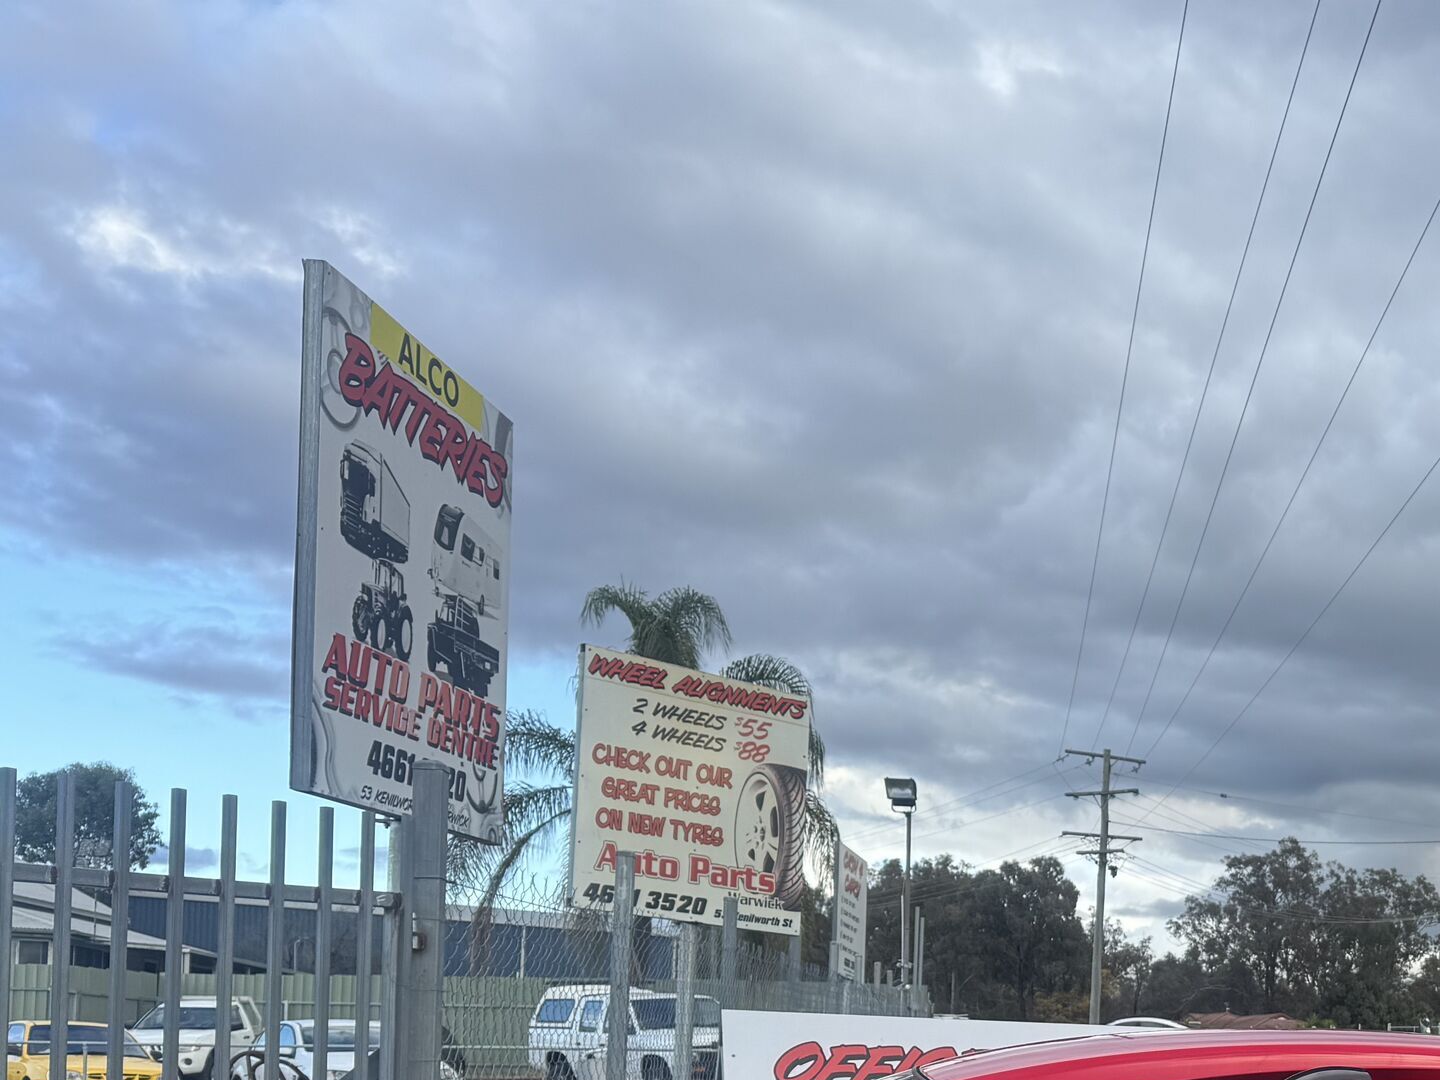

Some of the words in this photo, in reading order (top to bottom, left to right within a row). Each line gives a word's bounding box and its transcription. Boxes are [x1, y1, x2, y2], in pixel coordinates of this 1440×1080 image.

[399, 333, 459, 408] ALCO
[339, 332, 508, 508] BATTERIES
[321, 632, 411, 705] AUTO
[418, 671, 501, 743] PARTS
[323, 675, 422, 741] SERVICE
[588, 653, 668, 690] WHEEL
[672, 675, 808, 720] ALIGNMENTS
[633, 698, 648, 714] 2
[652, 702, 727, 731] WHEELS
[735, 717, 772, 740] $55
[366, 740, 415, 786] 4661
[632, 721, 646, 735] 4
[651, 725, 726, 752] WHEELS
[734, 741, 771, 763] $88
[592, 743, 651, 774] CHECK
[655, 755, 692, 781] OUT
[696, 763, 733, 789] OUR
[360, 785, 373, 801] 53
[601, 776, 660, 806] GREAT
[663, 787, 721, 816] PRICES
[595, 807, 623, 831] ON
[628, 811, 667, 838] NEW
[670, 819, 724, 847] TYRES
[688, 853, 777, 896] Parts
[583, 883, 641, 908] 461
[645, 891, 707, 917] 3520
[737, 911, 780, 927] enilworth
[782, 918, 793, 928] St
